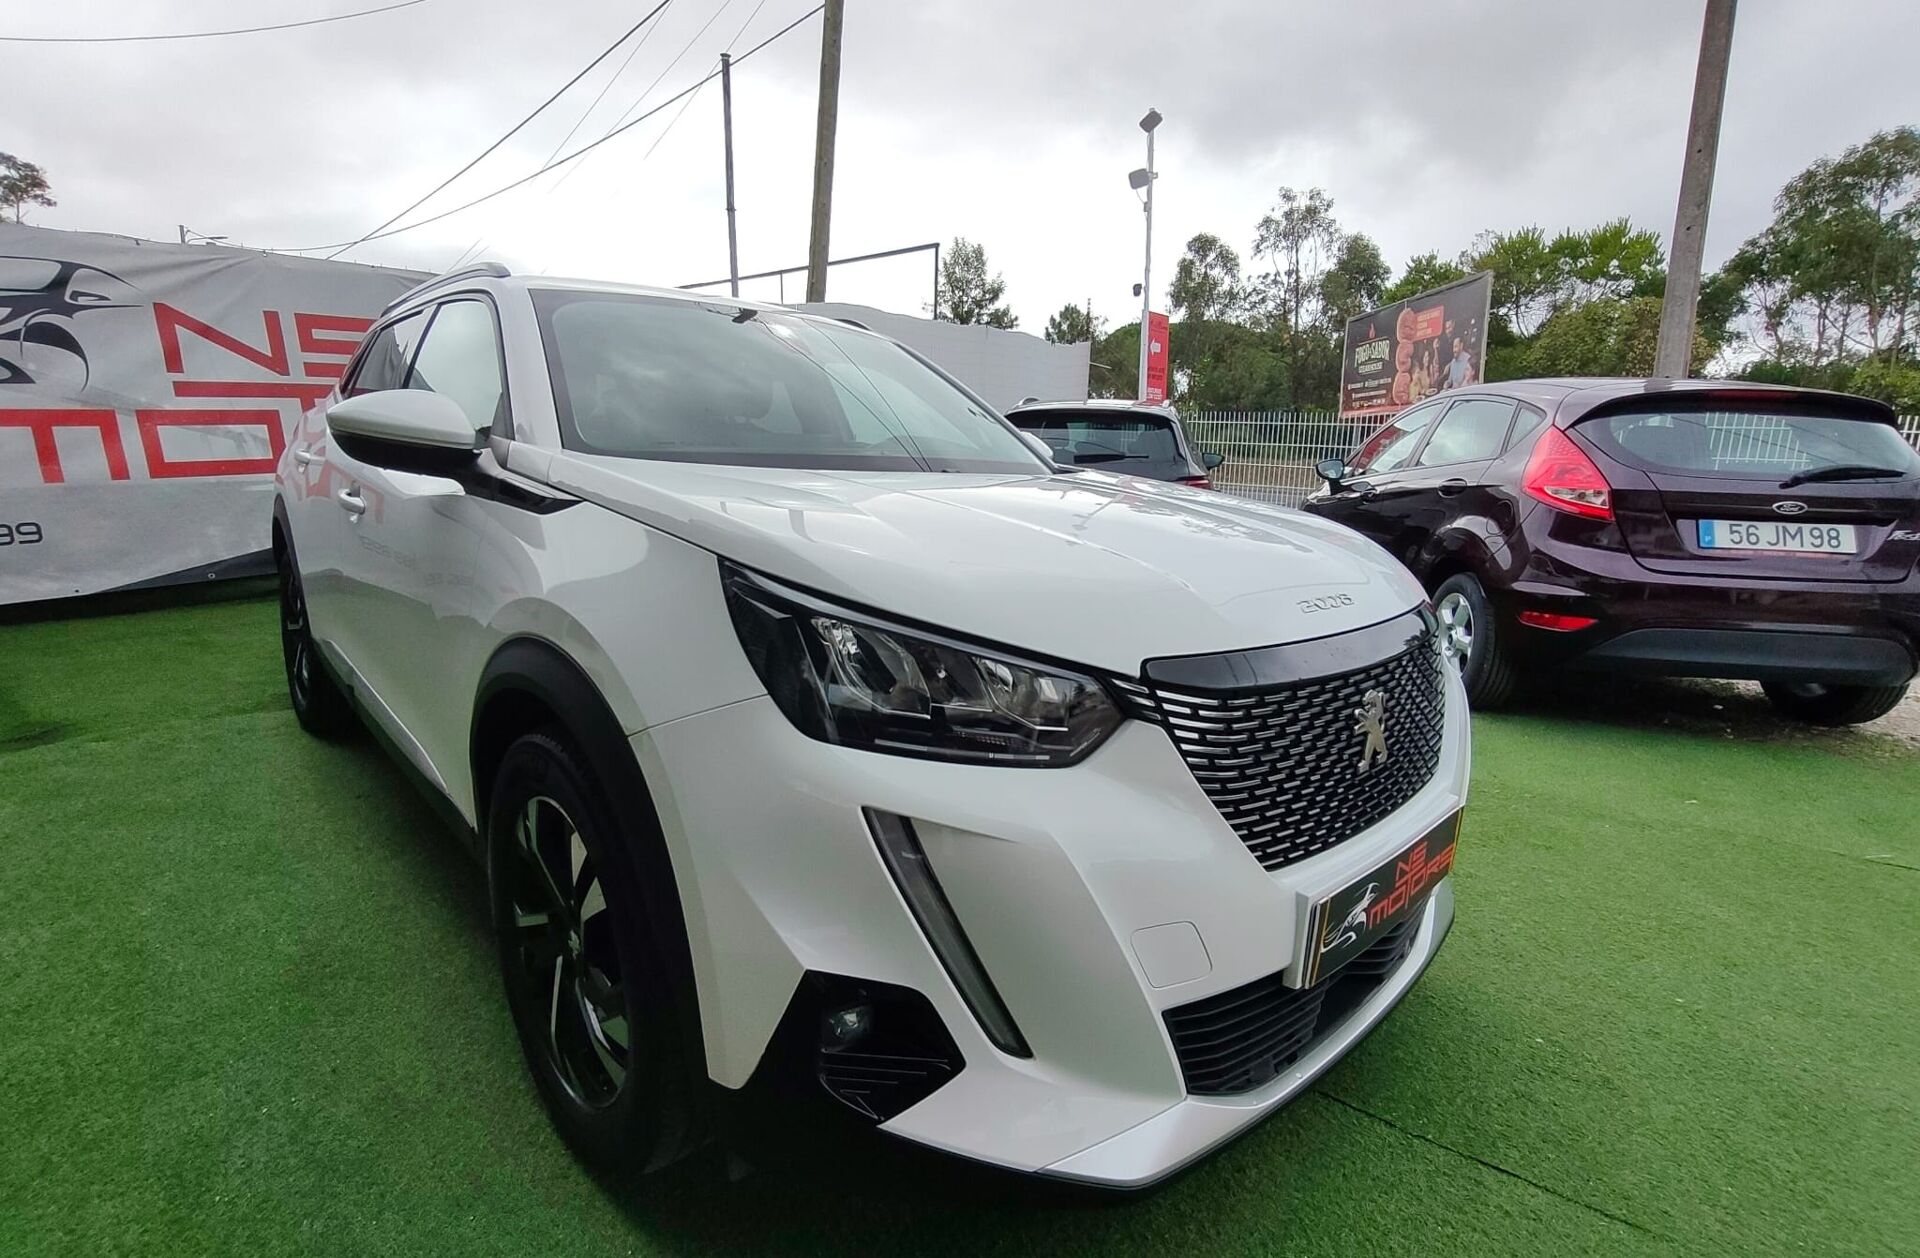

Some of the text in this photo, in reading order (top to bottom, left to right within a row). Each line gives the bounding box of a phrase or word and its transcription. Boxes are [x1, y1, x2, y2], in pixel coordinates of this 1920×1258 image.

[1729, 523, 1841, 549] 56 JM 98
